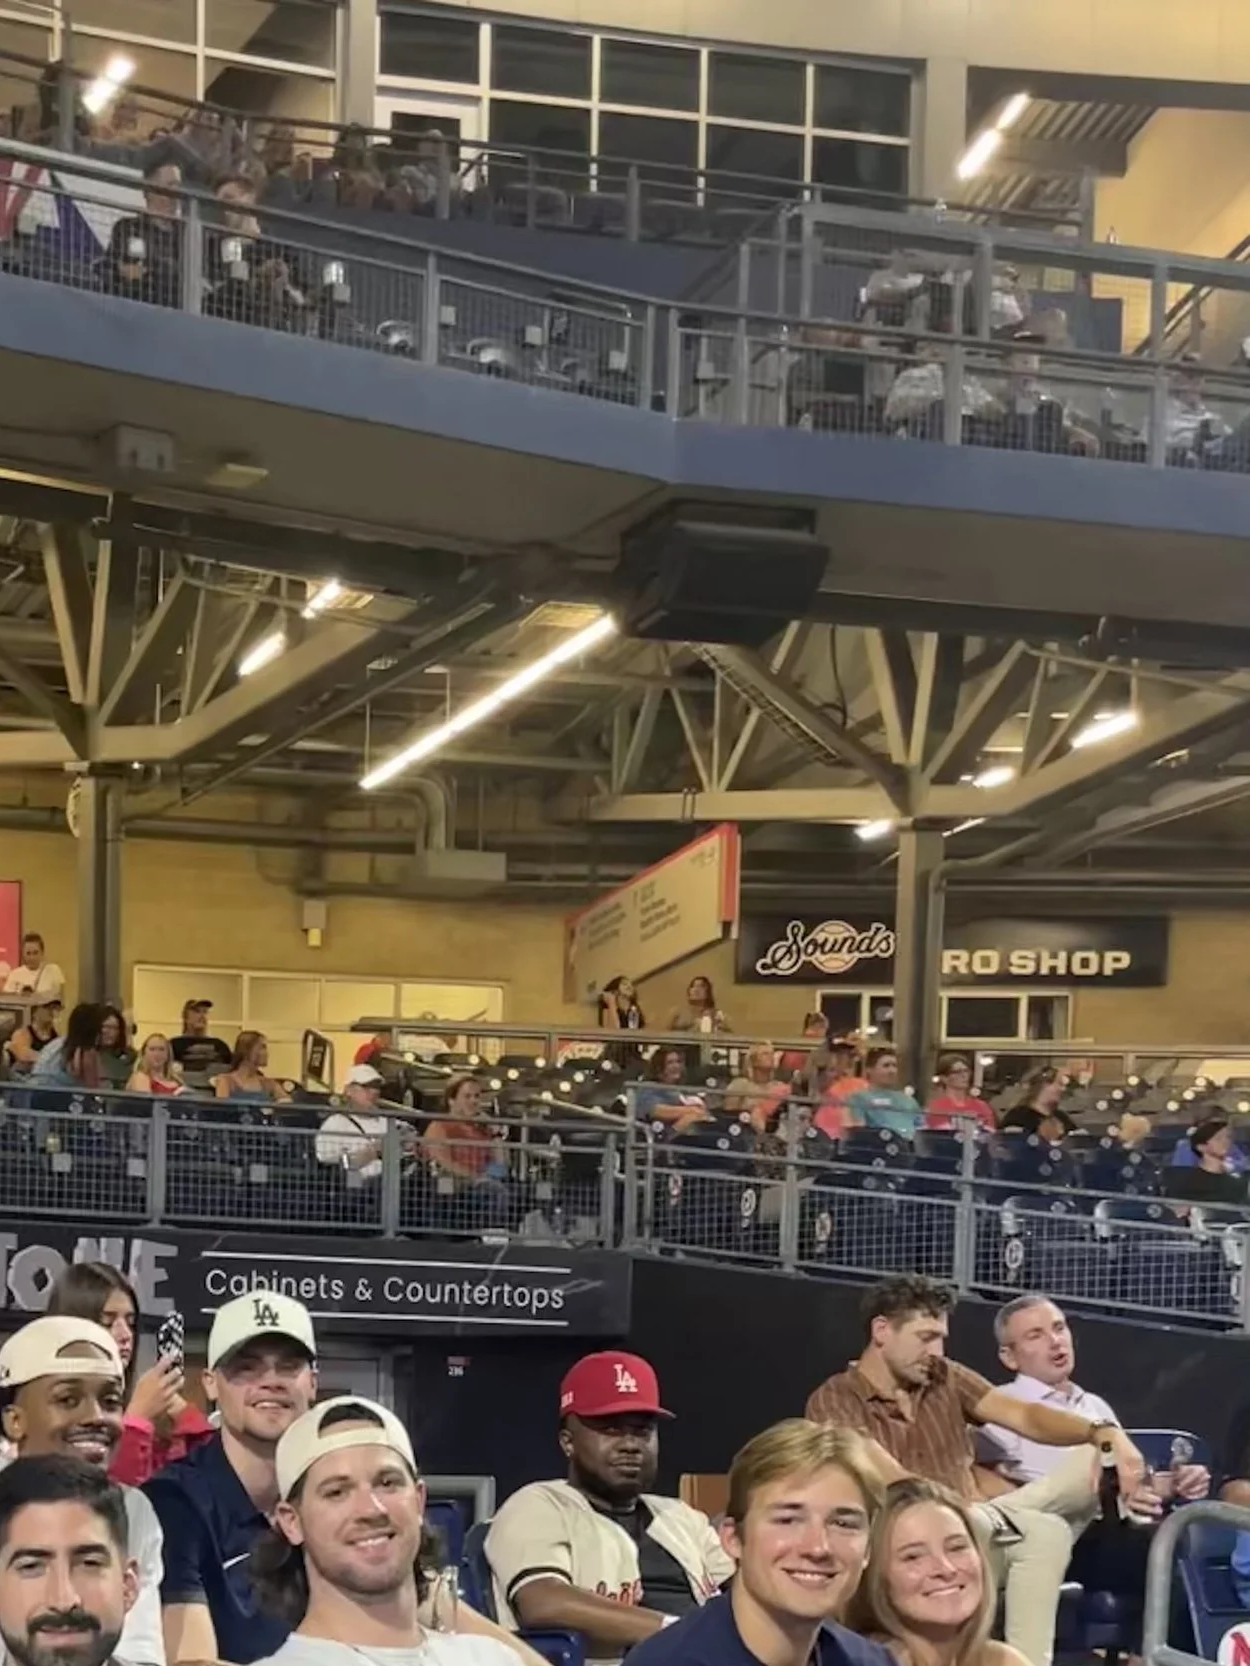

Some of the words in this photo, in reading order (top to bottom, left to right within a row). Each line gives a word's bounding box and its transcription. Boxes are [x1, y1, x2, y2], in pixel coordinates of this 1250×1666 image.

[756, 920, 896, 977] Sounds
[942, 948, 1000, 976] RO
[1008, 948, 1132, 977] SHOP
[204, 1268, 345, 1300] Cabinets
[354, 1277, 373, 1302] &
[383, 1276, 565, 1315] Countertops
[252, 1299, 280, 1327] LA
[613, 1363, 638, 1392] LA
